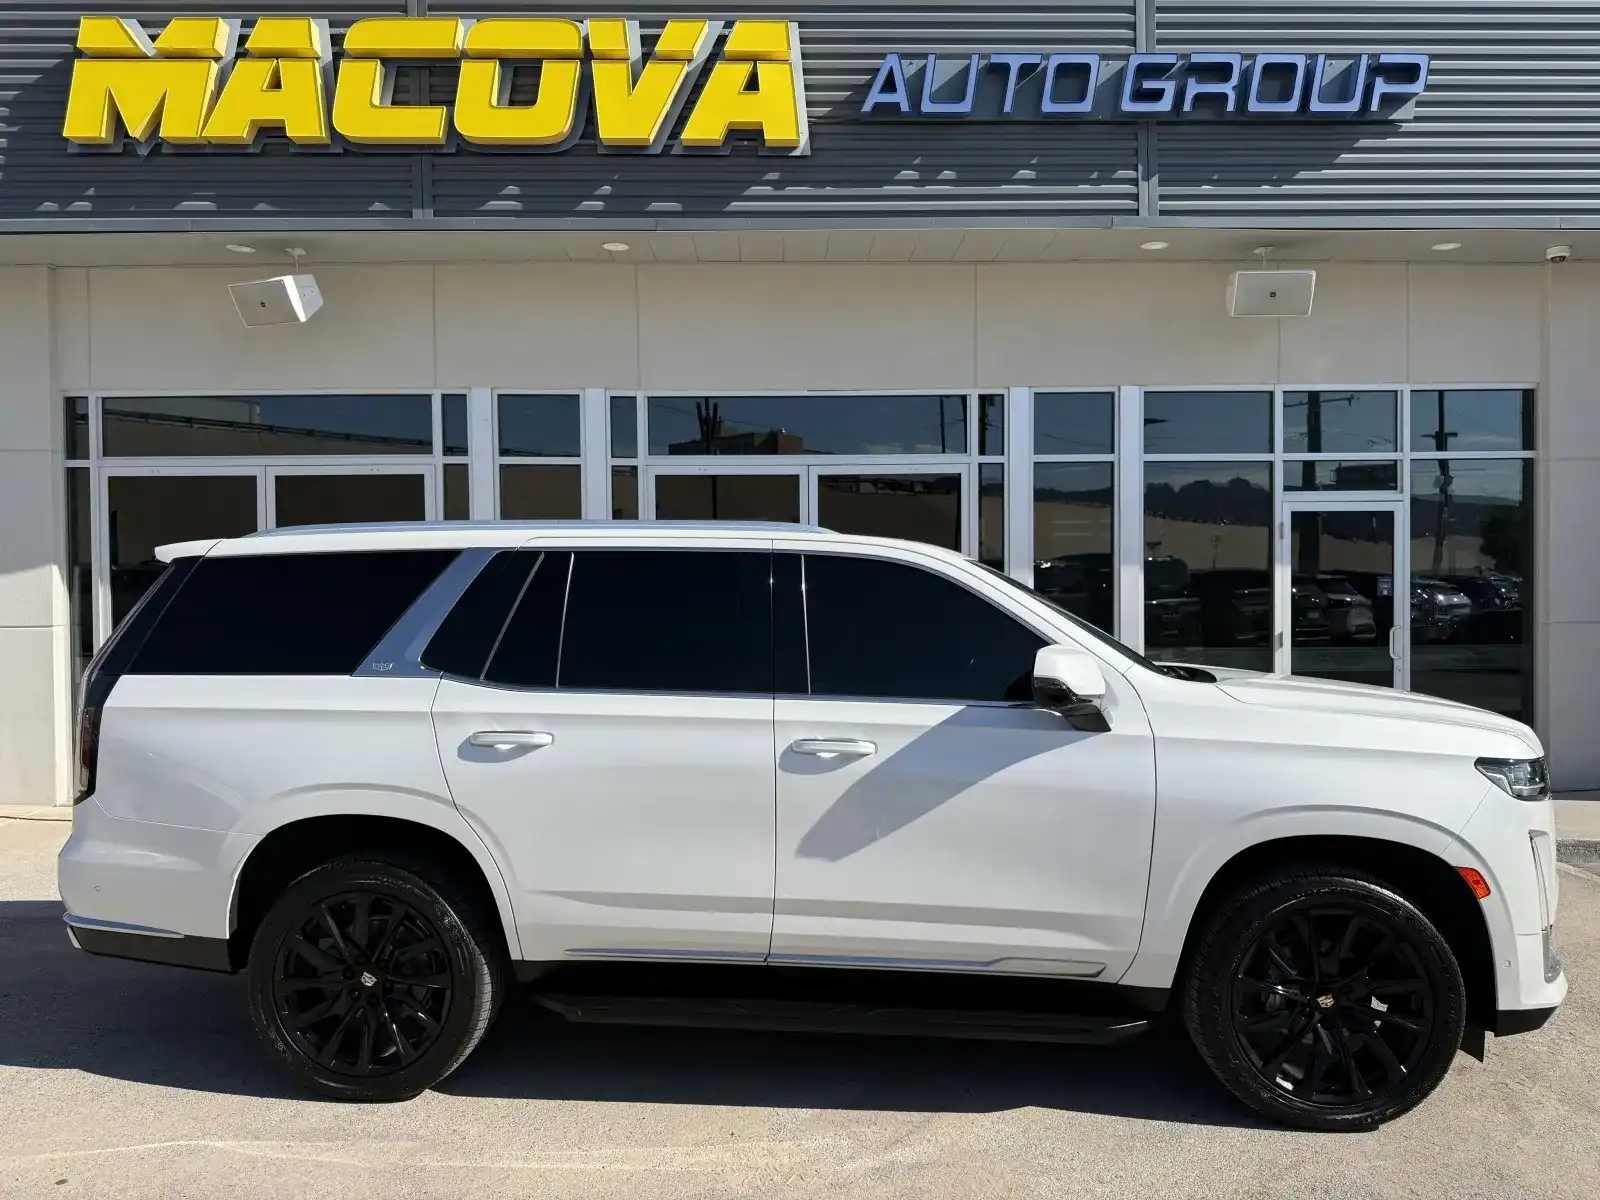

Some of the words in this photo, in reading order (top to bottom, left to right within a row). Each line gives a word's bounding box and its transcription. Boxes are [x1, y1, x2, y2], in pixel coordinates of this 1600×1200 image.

[63, 17, 804, 148] MACOVA
[861, 52, 1101, 115] AUTO
[1120, 52, 1431, 114] GROUP
